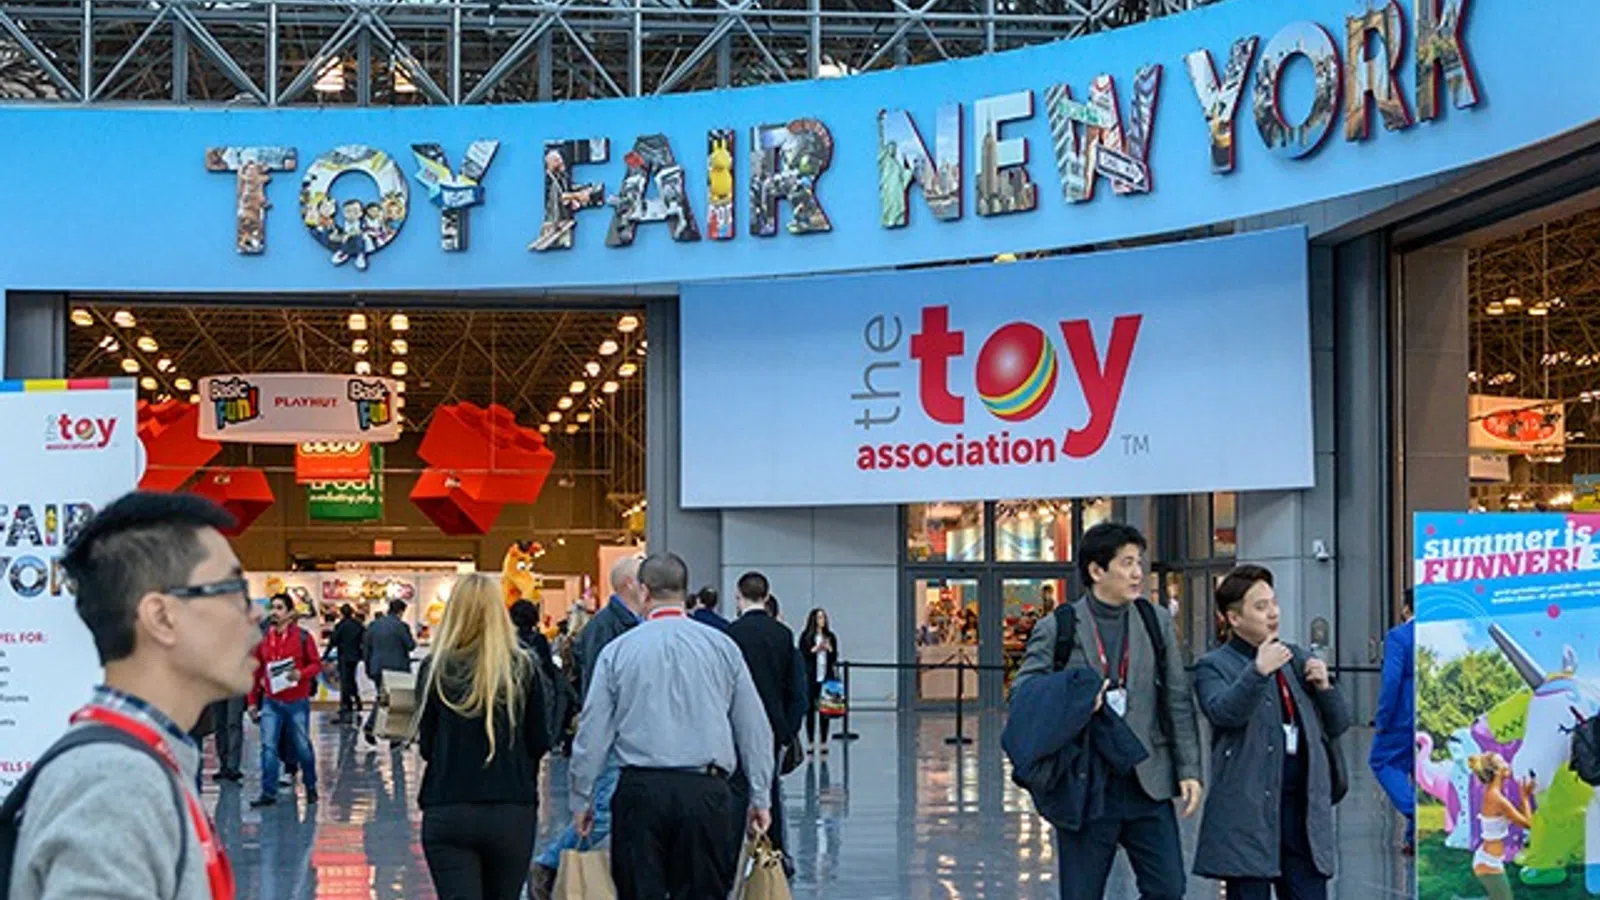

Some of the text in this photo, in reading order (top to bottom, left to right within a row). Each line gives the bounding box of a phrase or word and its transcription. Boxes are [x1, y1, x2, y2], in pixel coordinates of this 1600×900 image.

[205, 0, 1481, 271] TOY FAIR NEW YORK
[210, 377, 250, 399] Basic
[850, 314, 902, 430] the
[910, 304, 1143, 458] toy
[274, 396, 338, 408] PLAYHUT
[58, 413, 117, 448] toy
[857, 432, 1055, 471] association
[1424, 528, 1560, 560] summer
[1564, 519, 1593, 549] is
[1422, 546, 1583, 585] FUNNER!
